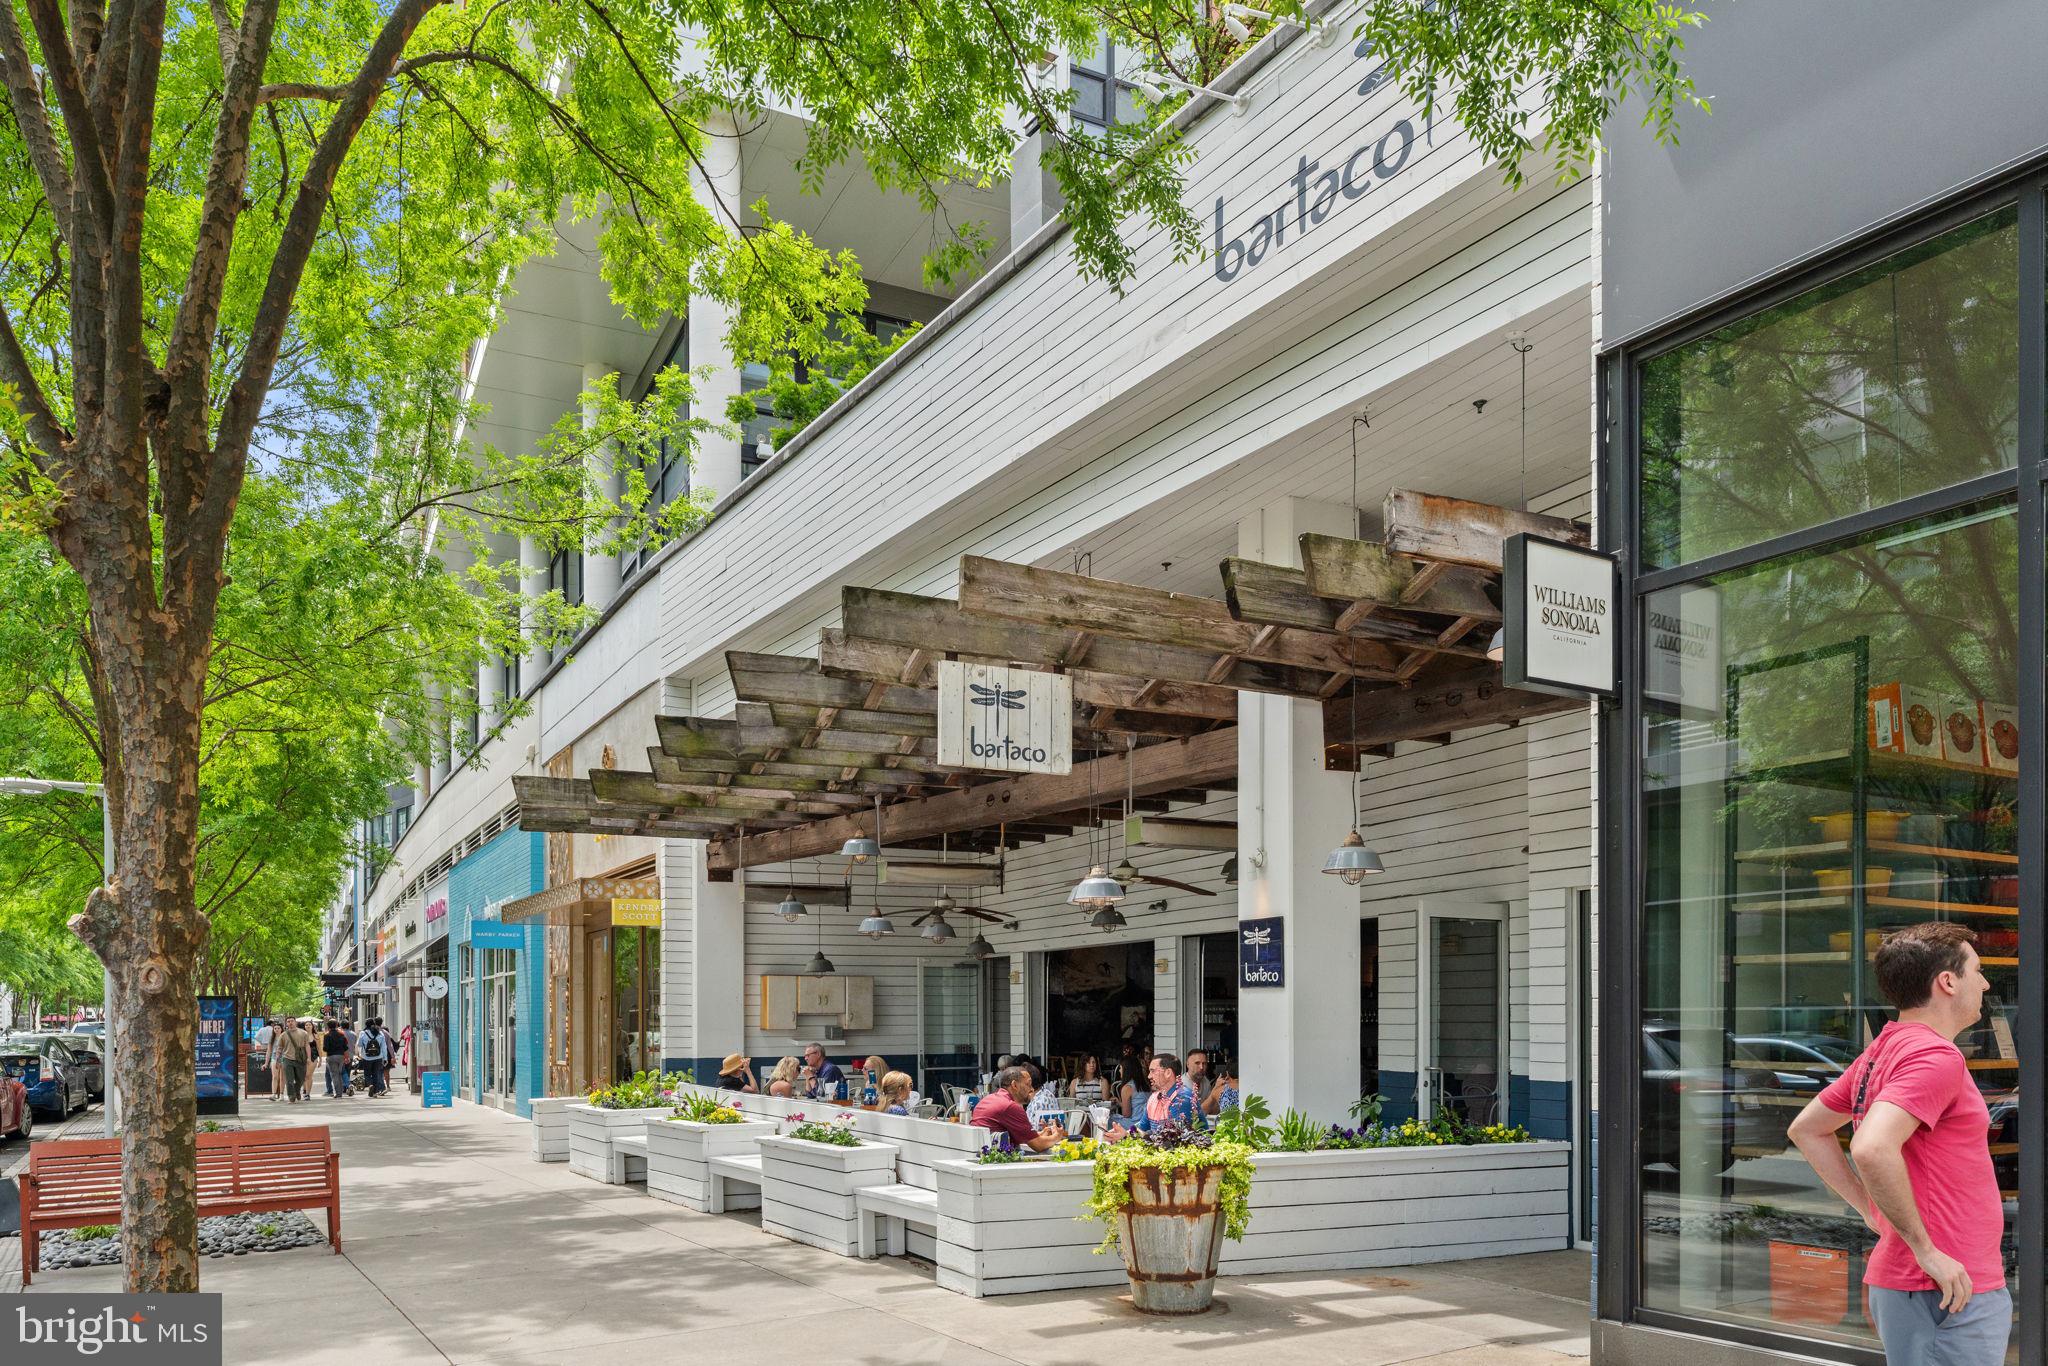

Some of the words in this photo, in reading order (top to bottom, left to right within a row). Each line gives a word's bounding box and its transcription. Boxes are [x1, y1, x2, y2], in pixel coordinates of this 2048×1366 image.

[1215, 119, 1415, 283] bartaco
[1533, 584, 1606, 616] WILLIAMS
[1541, 606, 1600, 635] SONOMA
[1552, 634, 1587, 646] CALIFORNIA
[970, 725, 1046, 763] bartaco
[618, 903, 661, 912] KENDRA
[622, 912, 656, 920] SCOTT
[1244, 962, 1279, 982] bartaco
